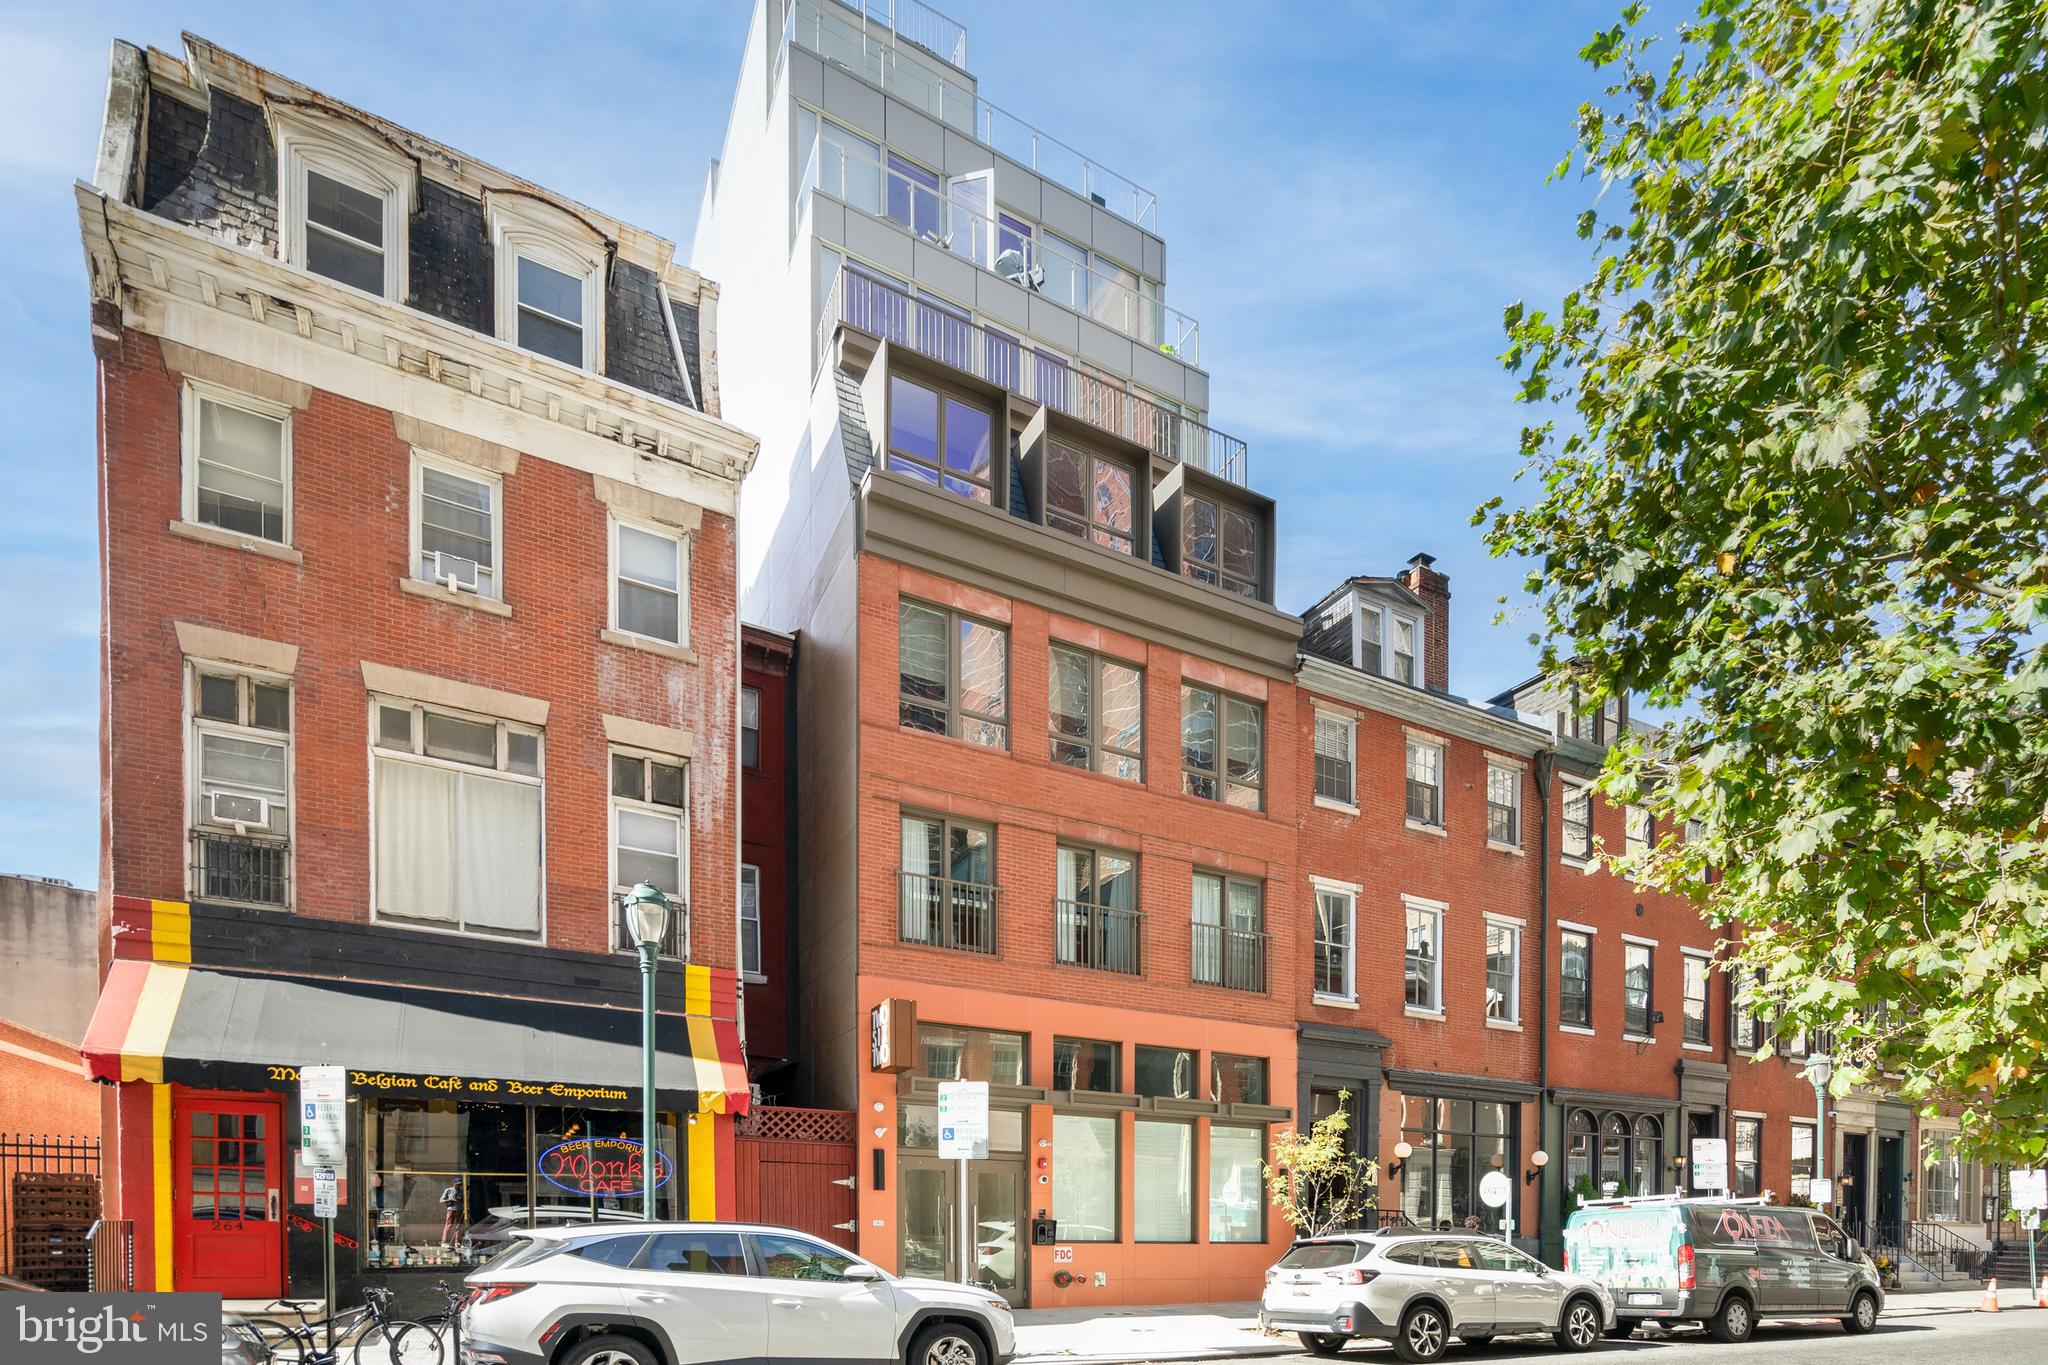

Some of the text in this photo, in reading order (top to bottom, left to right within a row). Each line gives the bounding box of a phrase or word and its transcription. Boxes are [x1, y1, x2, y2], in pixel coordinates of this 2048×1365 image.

[872, 1003, 888, 1029] TWO
[872, 1045, 889, 1067] TWO
[350, 1071, 418, 1089] Belgian
[424, 1076, 462, 1093] Café
[469, 1079, 498, 1092] and
[506, 1081, 544, 1095] Beer
[546, 1083, 628, 1100] Emporium
[560, 1140, 645, 1153] BEER EMPORIU
[579, 1179, 634, 1192] CAFE
[211, 1220, 244, 1231] 264
[1054, 1249, 1072, 1260] FDC
